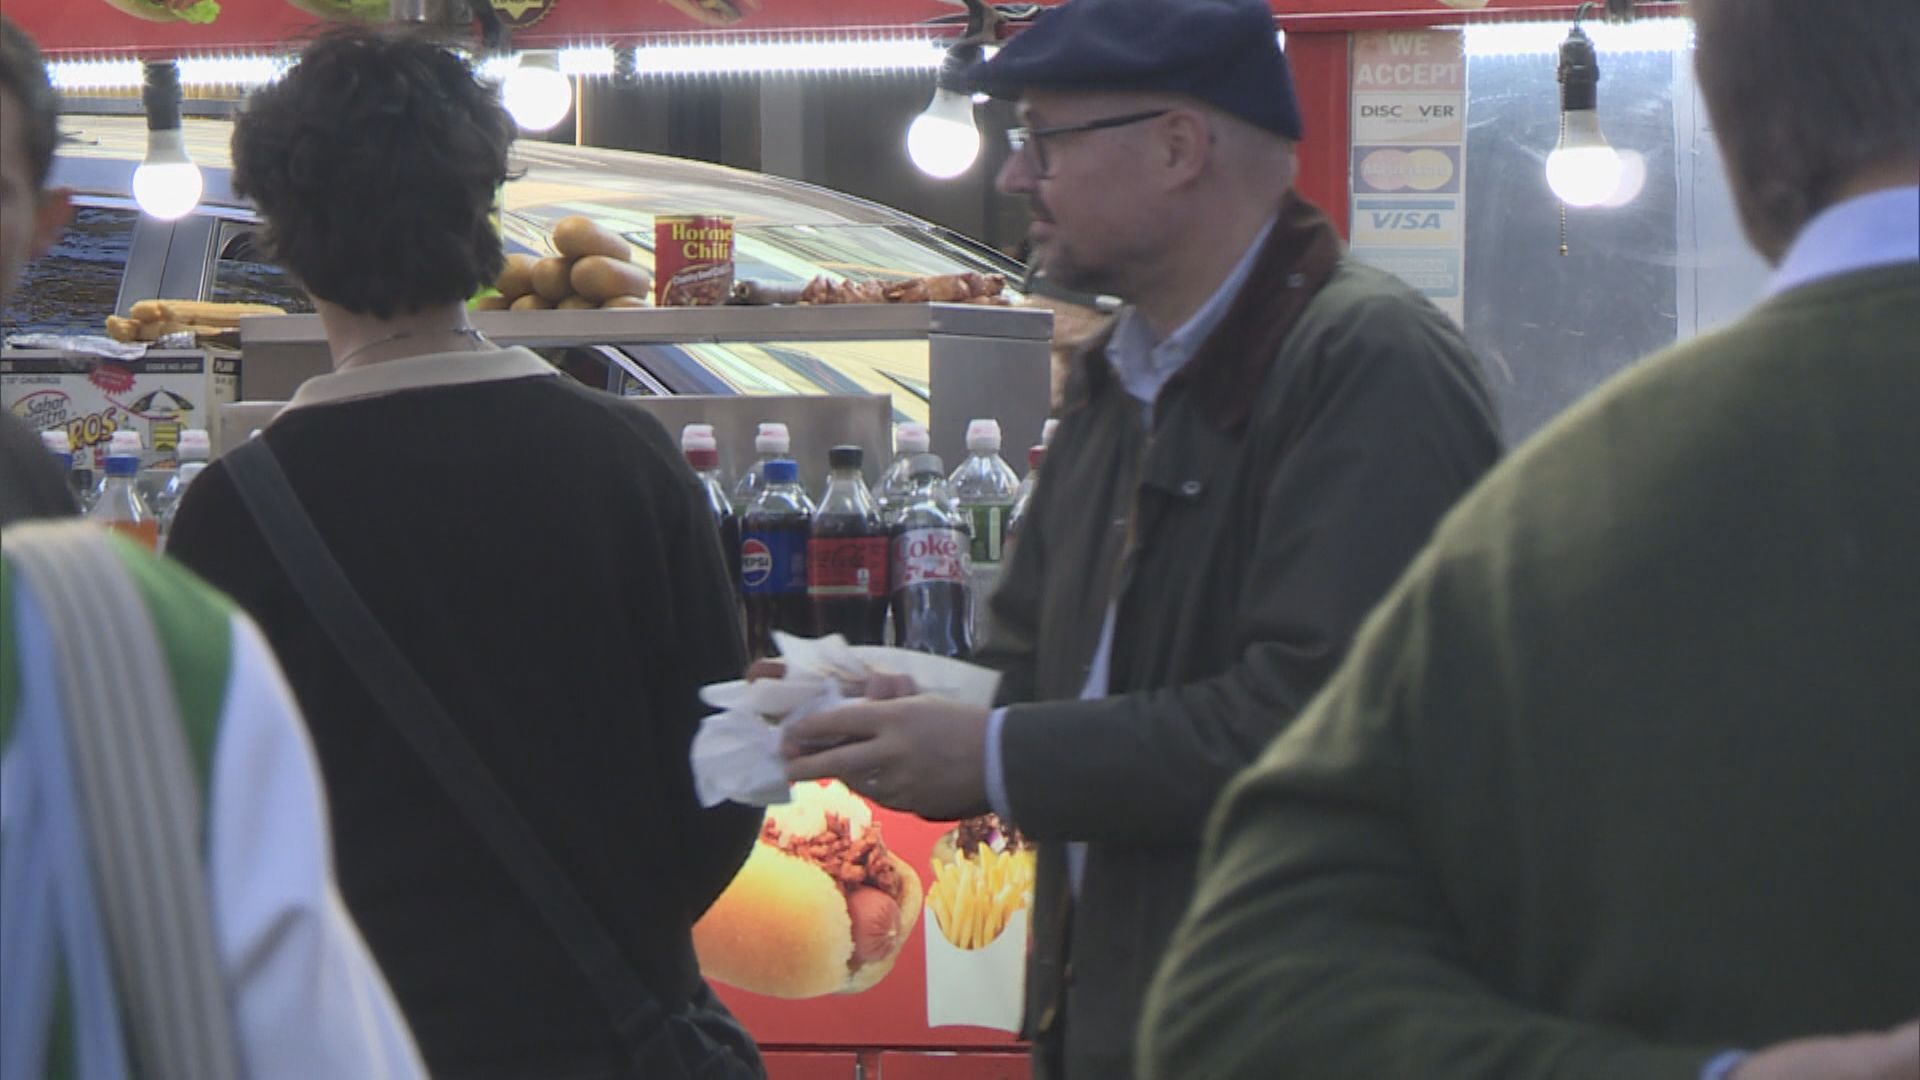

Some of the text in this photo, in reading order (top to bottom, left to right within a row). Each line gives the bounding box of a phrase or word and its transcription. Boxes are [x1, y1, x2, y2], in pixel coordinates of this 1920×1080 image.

[1388, 34, 1430, 56] WE
[1357, 63, 1457, 84] ACCEPT
[1361, 104, 1455, 118] DISCVER
[1371, 212, 1441, 230] VISA
[672, 223, 732, 240] Horme
[682, 241, 728, 259] Chili
[27, 396, 65, 416] Sabor
[893, 533, 958, 561] Coke
